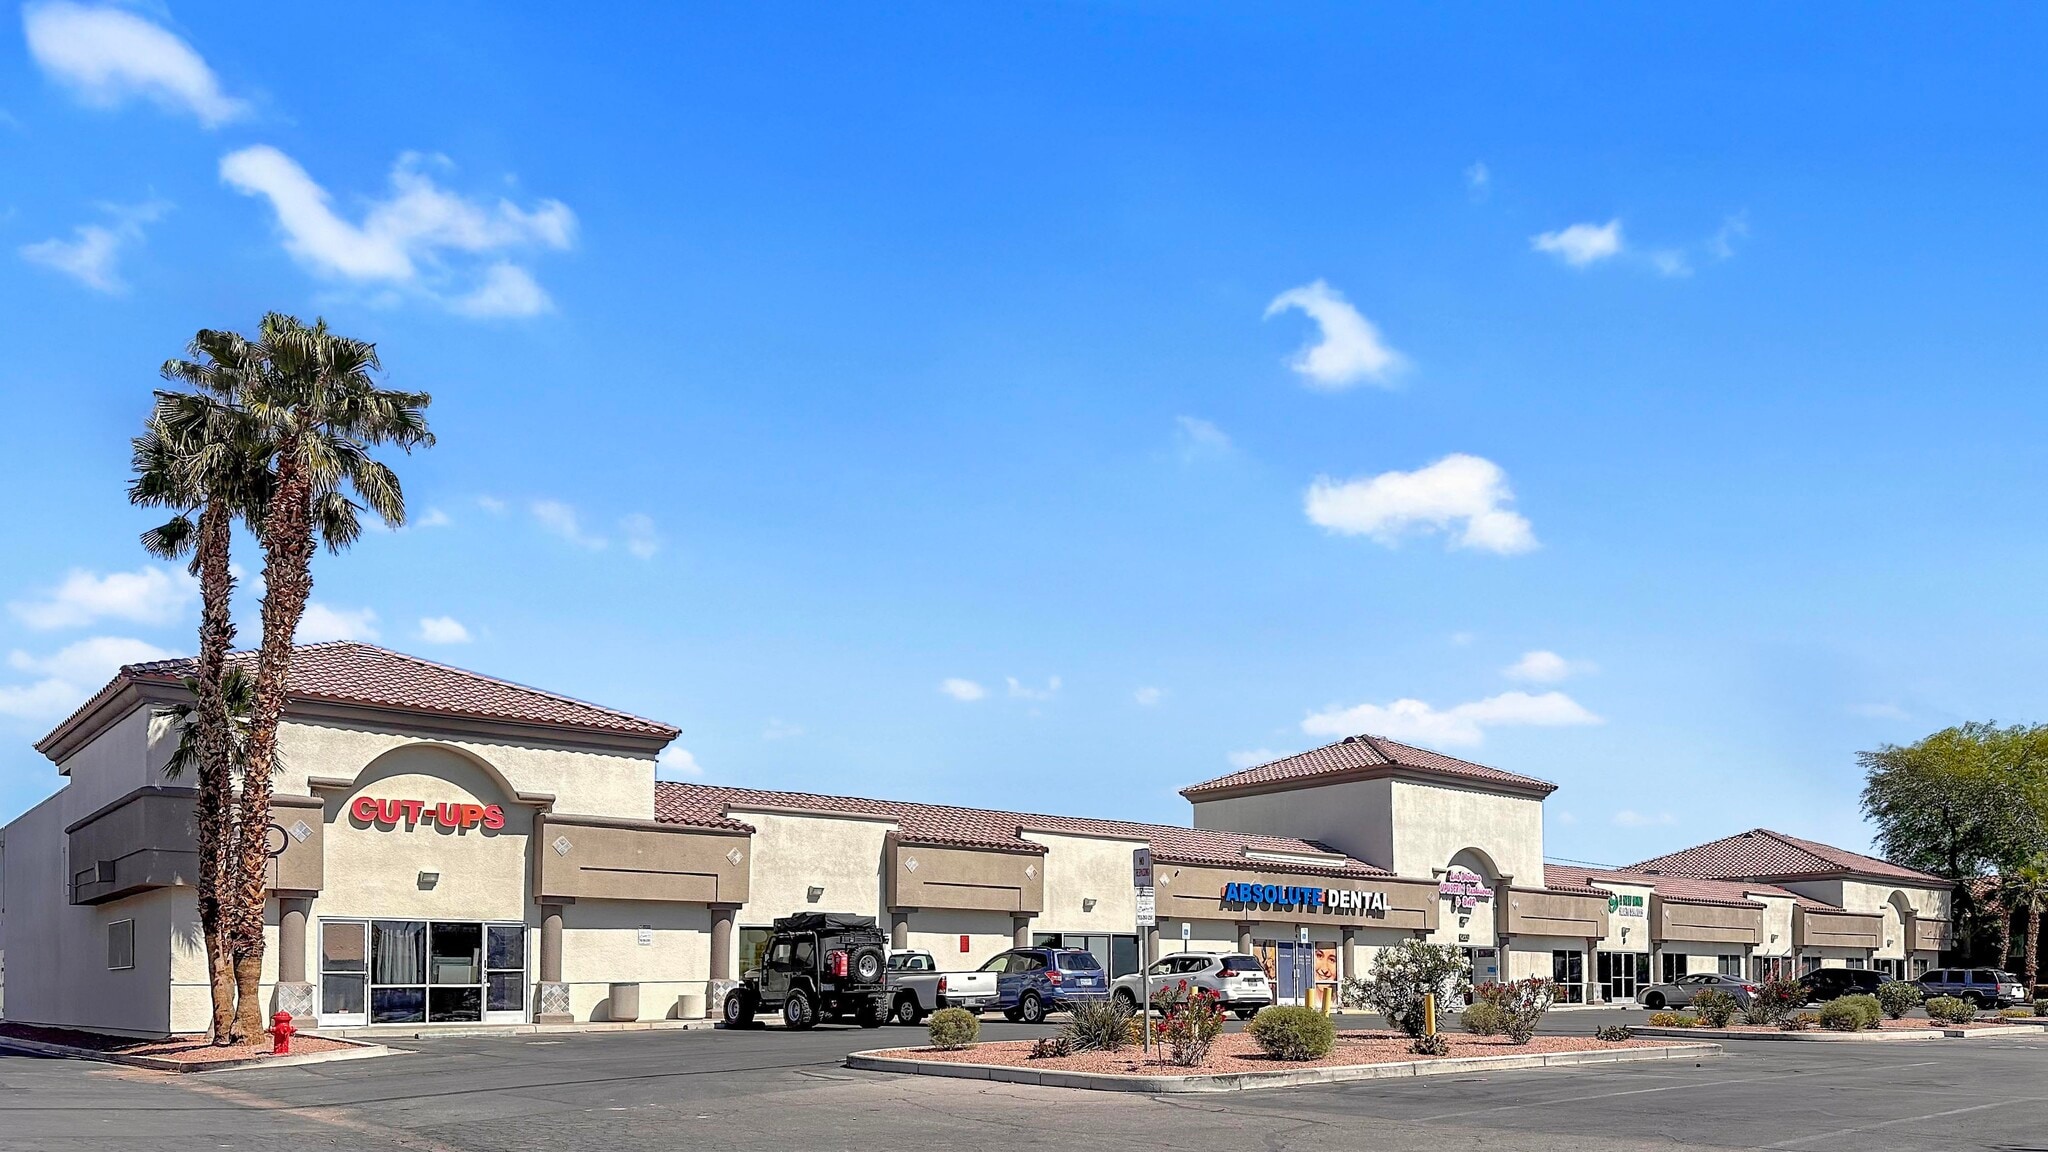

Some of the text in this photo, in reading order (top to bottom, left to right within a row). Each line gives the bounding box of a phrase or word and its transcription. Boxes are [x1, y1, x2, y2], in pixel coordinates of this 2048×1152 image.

[351, 796, 506, 830] CUT-UPS
[1225, 882, 1393, 911] ABSOLUTE DENTAL
